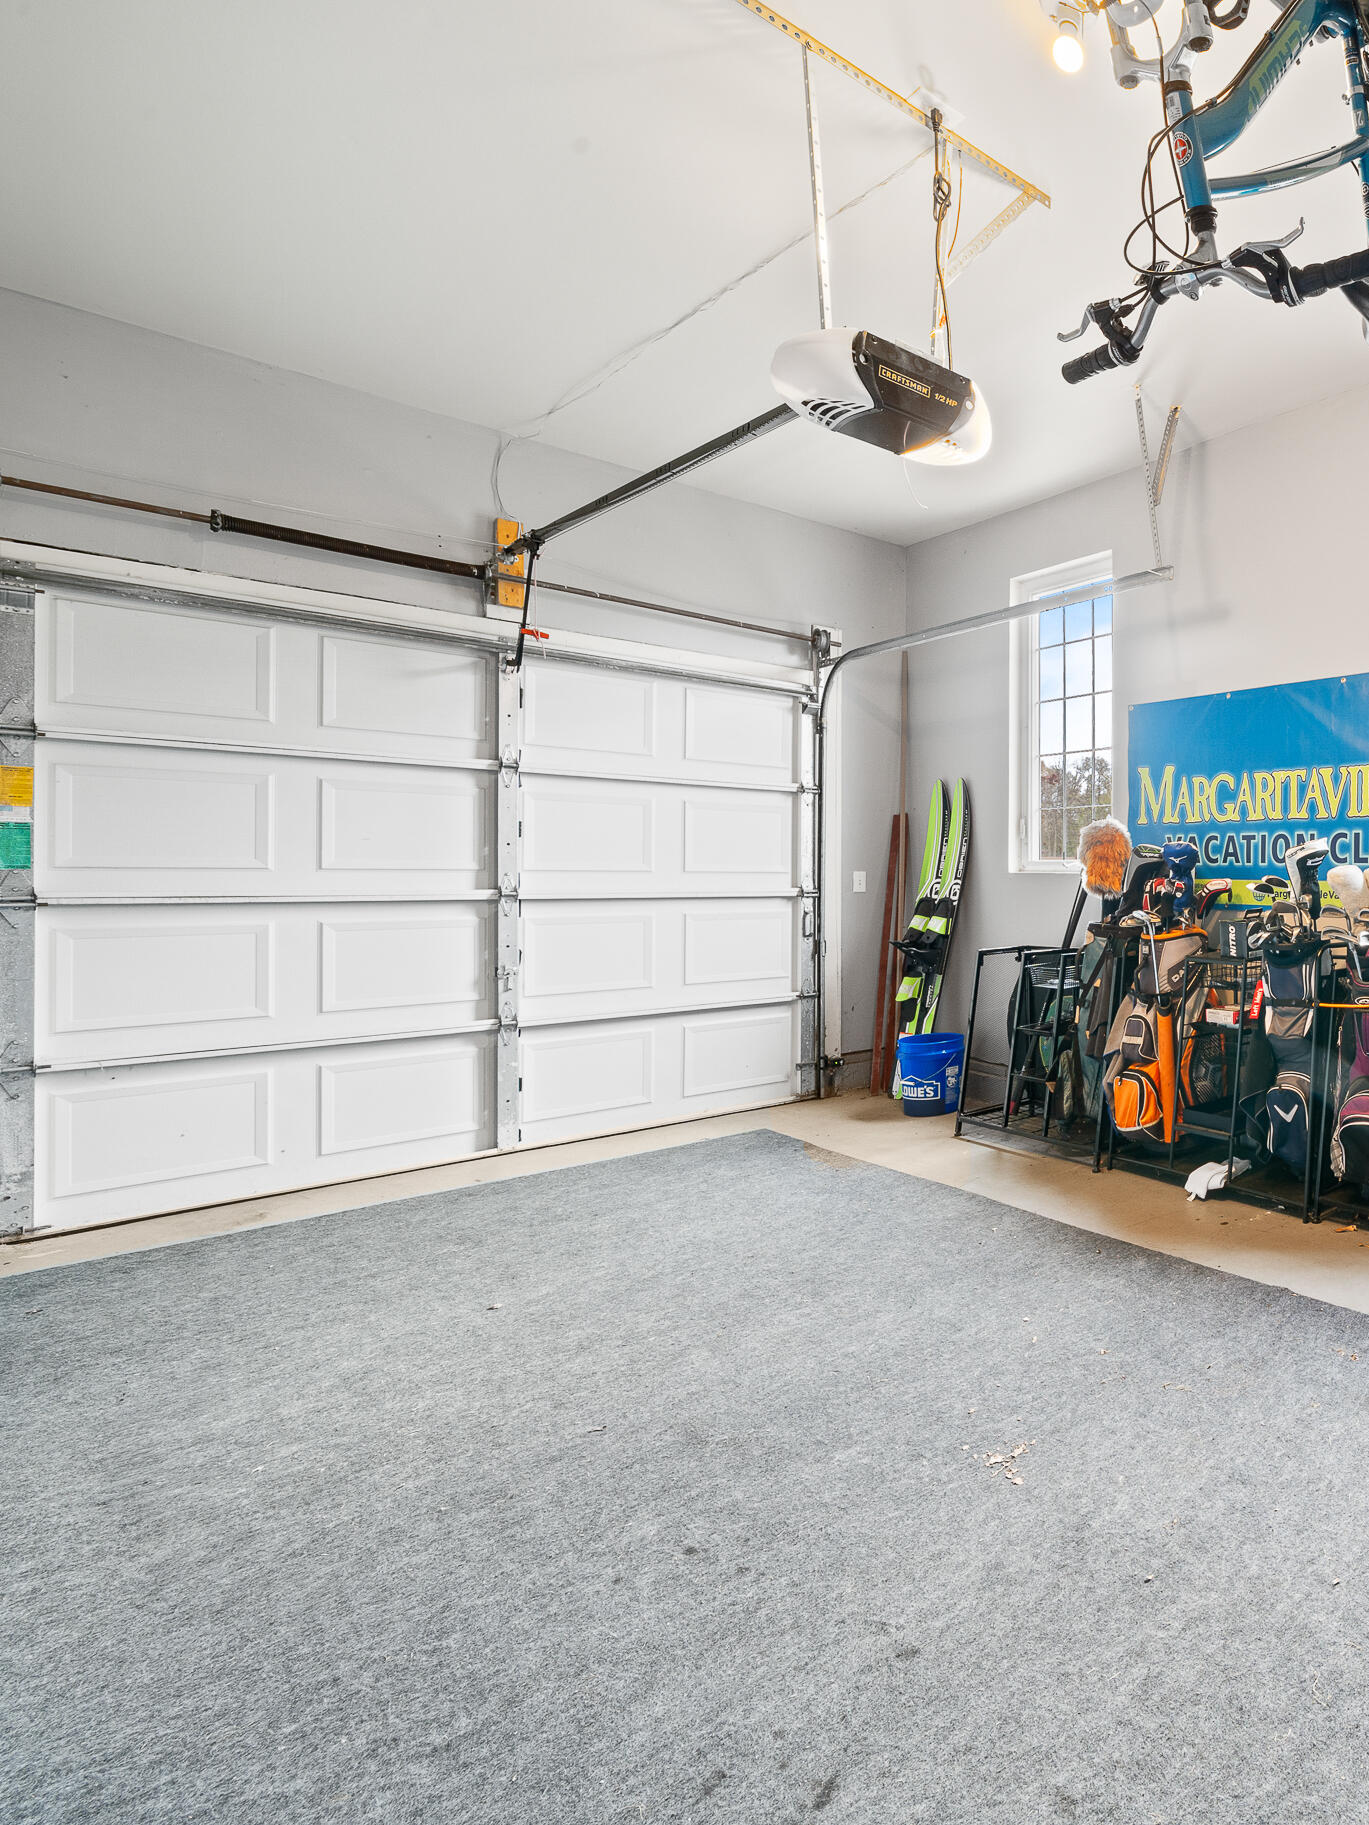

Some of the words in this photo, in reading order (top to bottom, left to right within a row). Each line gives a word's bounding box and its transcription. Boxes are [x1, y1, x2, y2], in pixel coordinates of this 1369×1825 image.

[881, 369, 929, 395] CRAFTSMAN
[934, 393, 946, 403] 1/2
[945, 397, 958, 407] HP
[1228, 925, 1237, 957] NITRO
[903, 1085, 935, 1098] OWE'S
